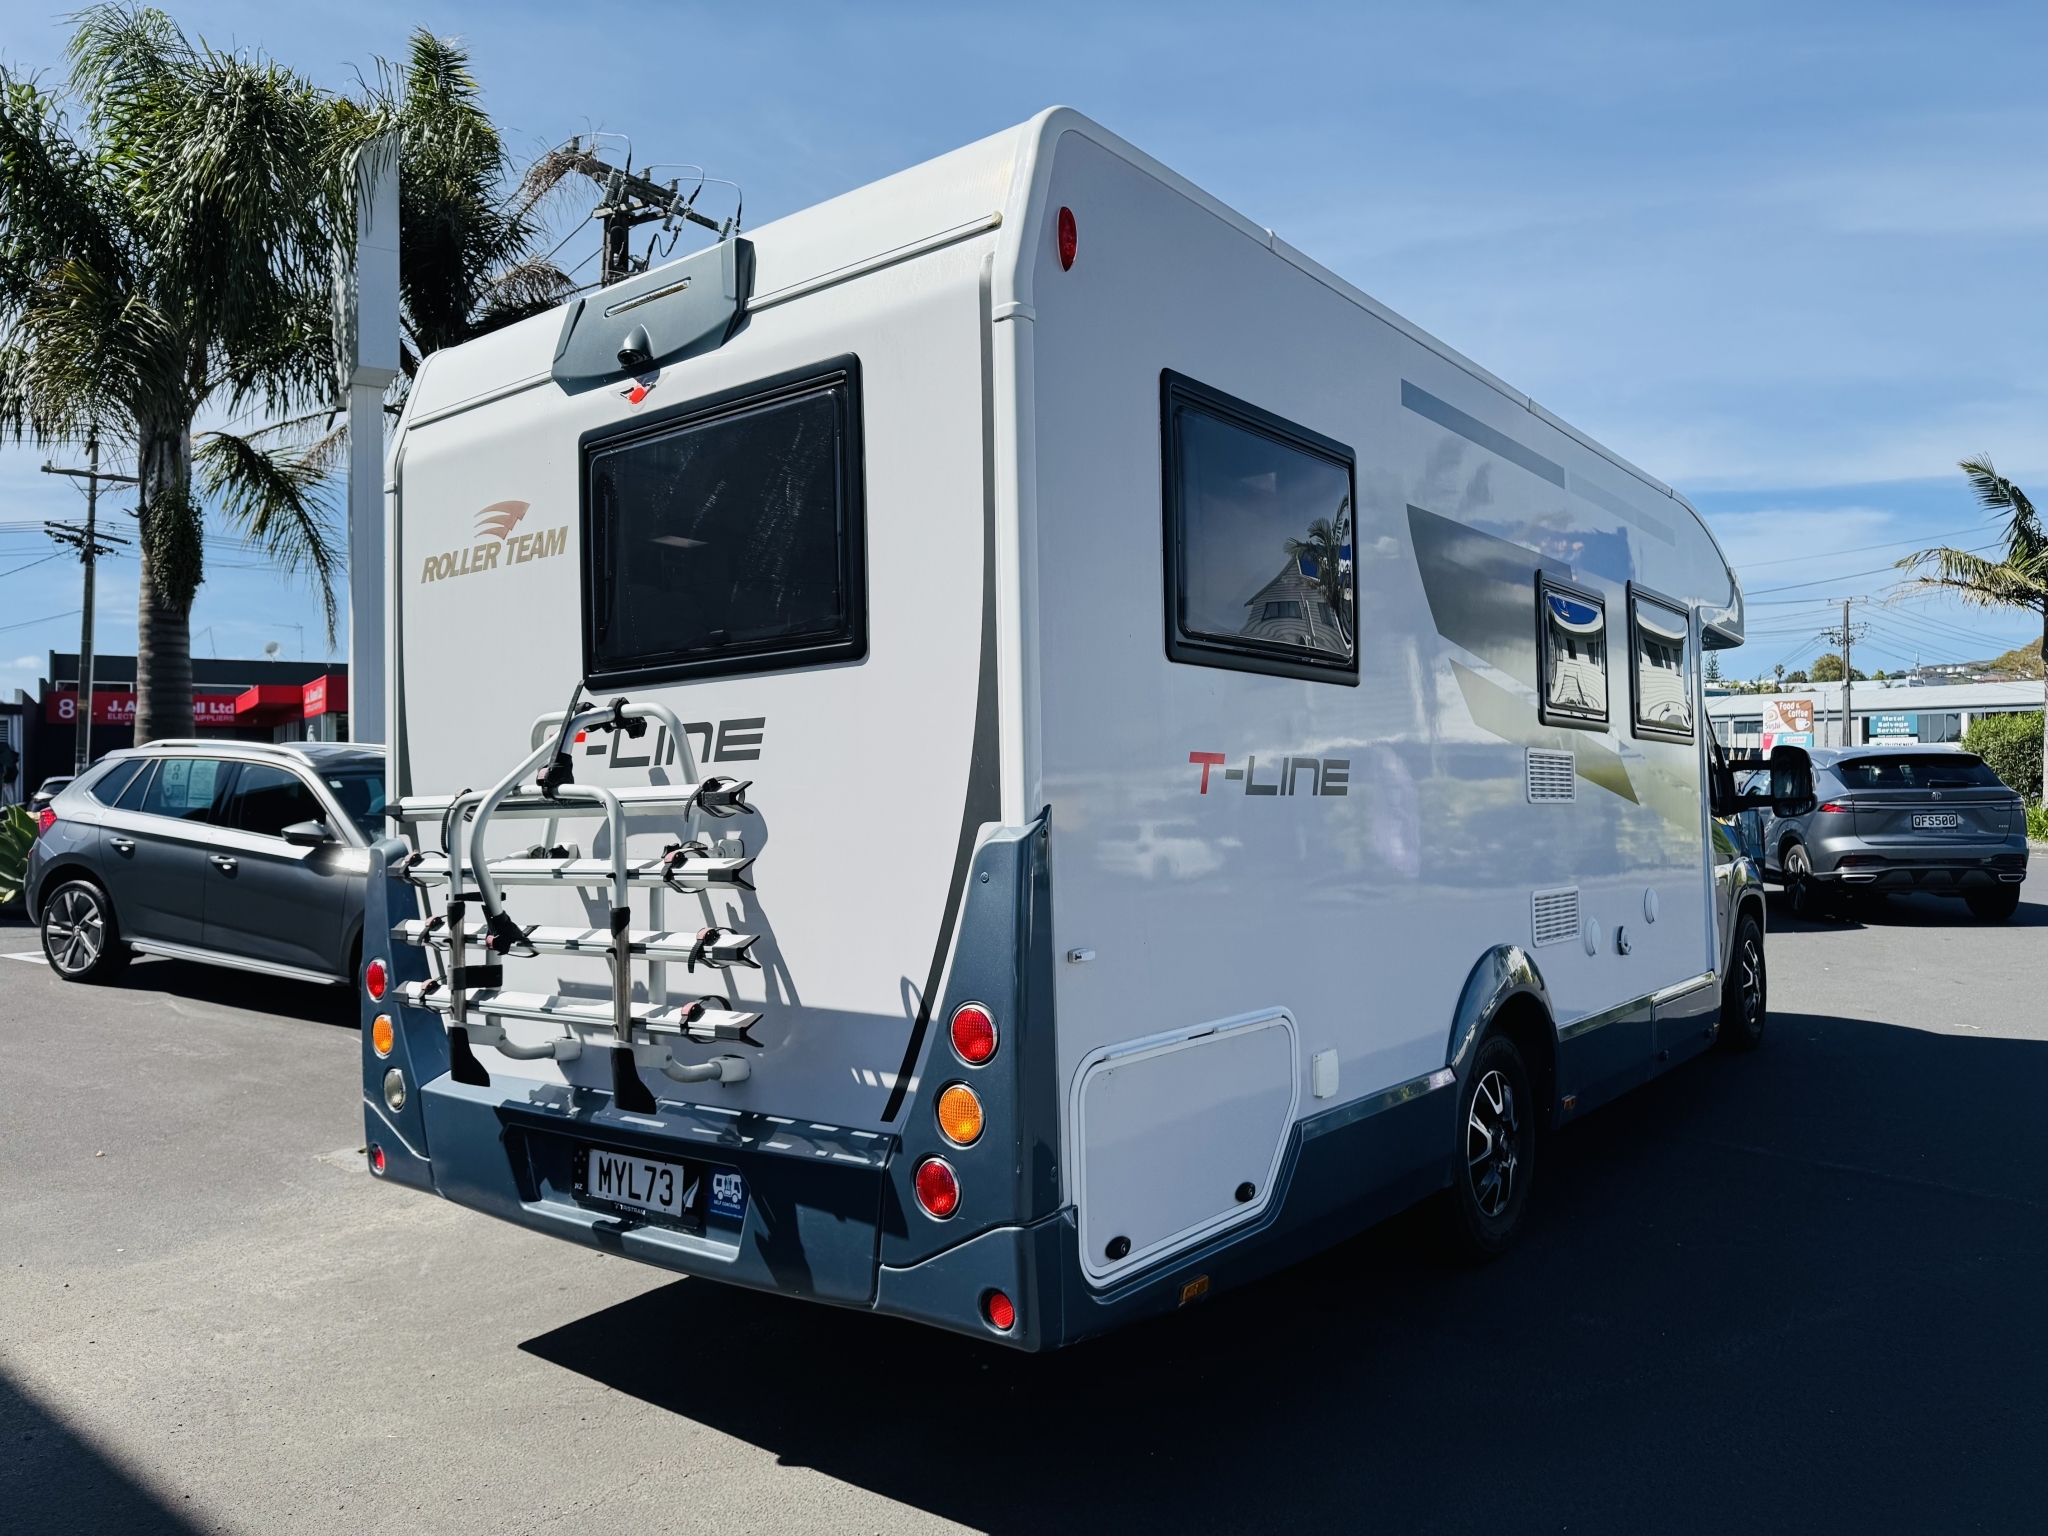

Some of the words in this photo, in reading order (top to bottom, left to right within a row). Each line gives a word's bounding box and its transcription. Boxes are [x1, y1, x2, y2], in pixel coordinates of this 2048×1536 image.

[421, 541, 501, 584] ROLLER
[506, 525, 568, 566] TEAM
[210, 702, 235, 714] Ltd
[1780, 701, 1795, 711] Food
[1788, 709, 1809, 718] Coffee
[1765, 721, 1781, 730] Sushi
[549, 717, 766, 768] -LINE
[1189, 751, 1350, 796] T-LINE
[1914, 815, 1956, 826] QFS500
[574, 1182, 583, 1190] NZ
[598, 1156, 674, 1207] MYL73
[619, 1203, 646, 1216] TRISTRAM
